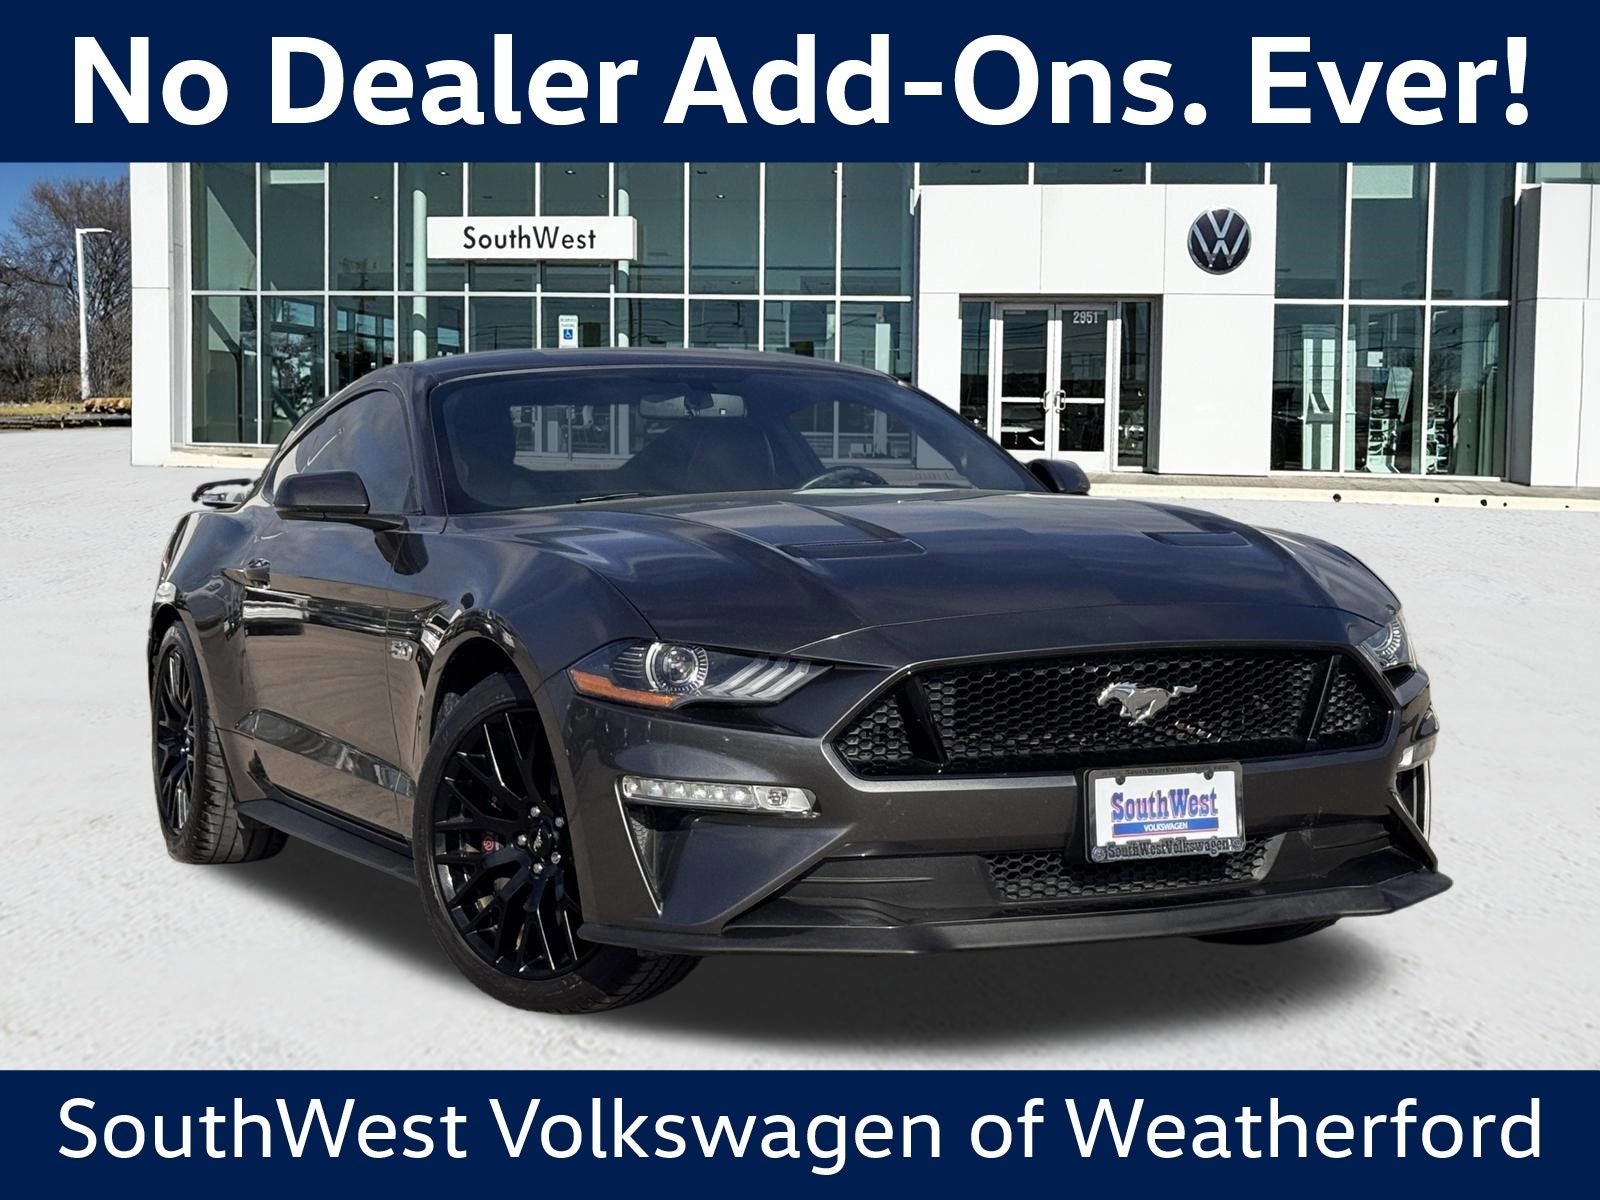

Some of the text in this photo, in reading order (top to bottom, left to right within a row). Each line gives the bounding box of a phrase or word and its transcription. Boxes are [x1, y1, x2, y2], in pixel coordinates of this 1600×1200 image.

[463, 225, 596, 250] SouthWest
[1072, 311, 1097, 324] 2951
[1111, 787, 1218, 822] SouthWest
[1144, 821, 1188, 832] VOLKSWAGEN
